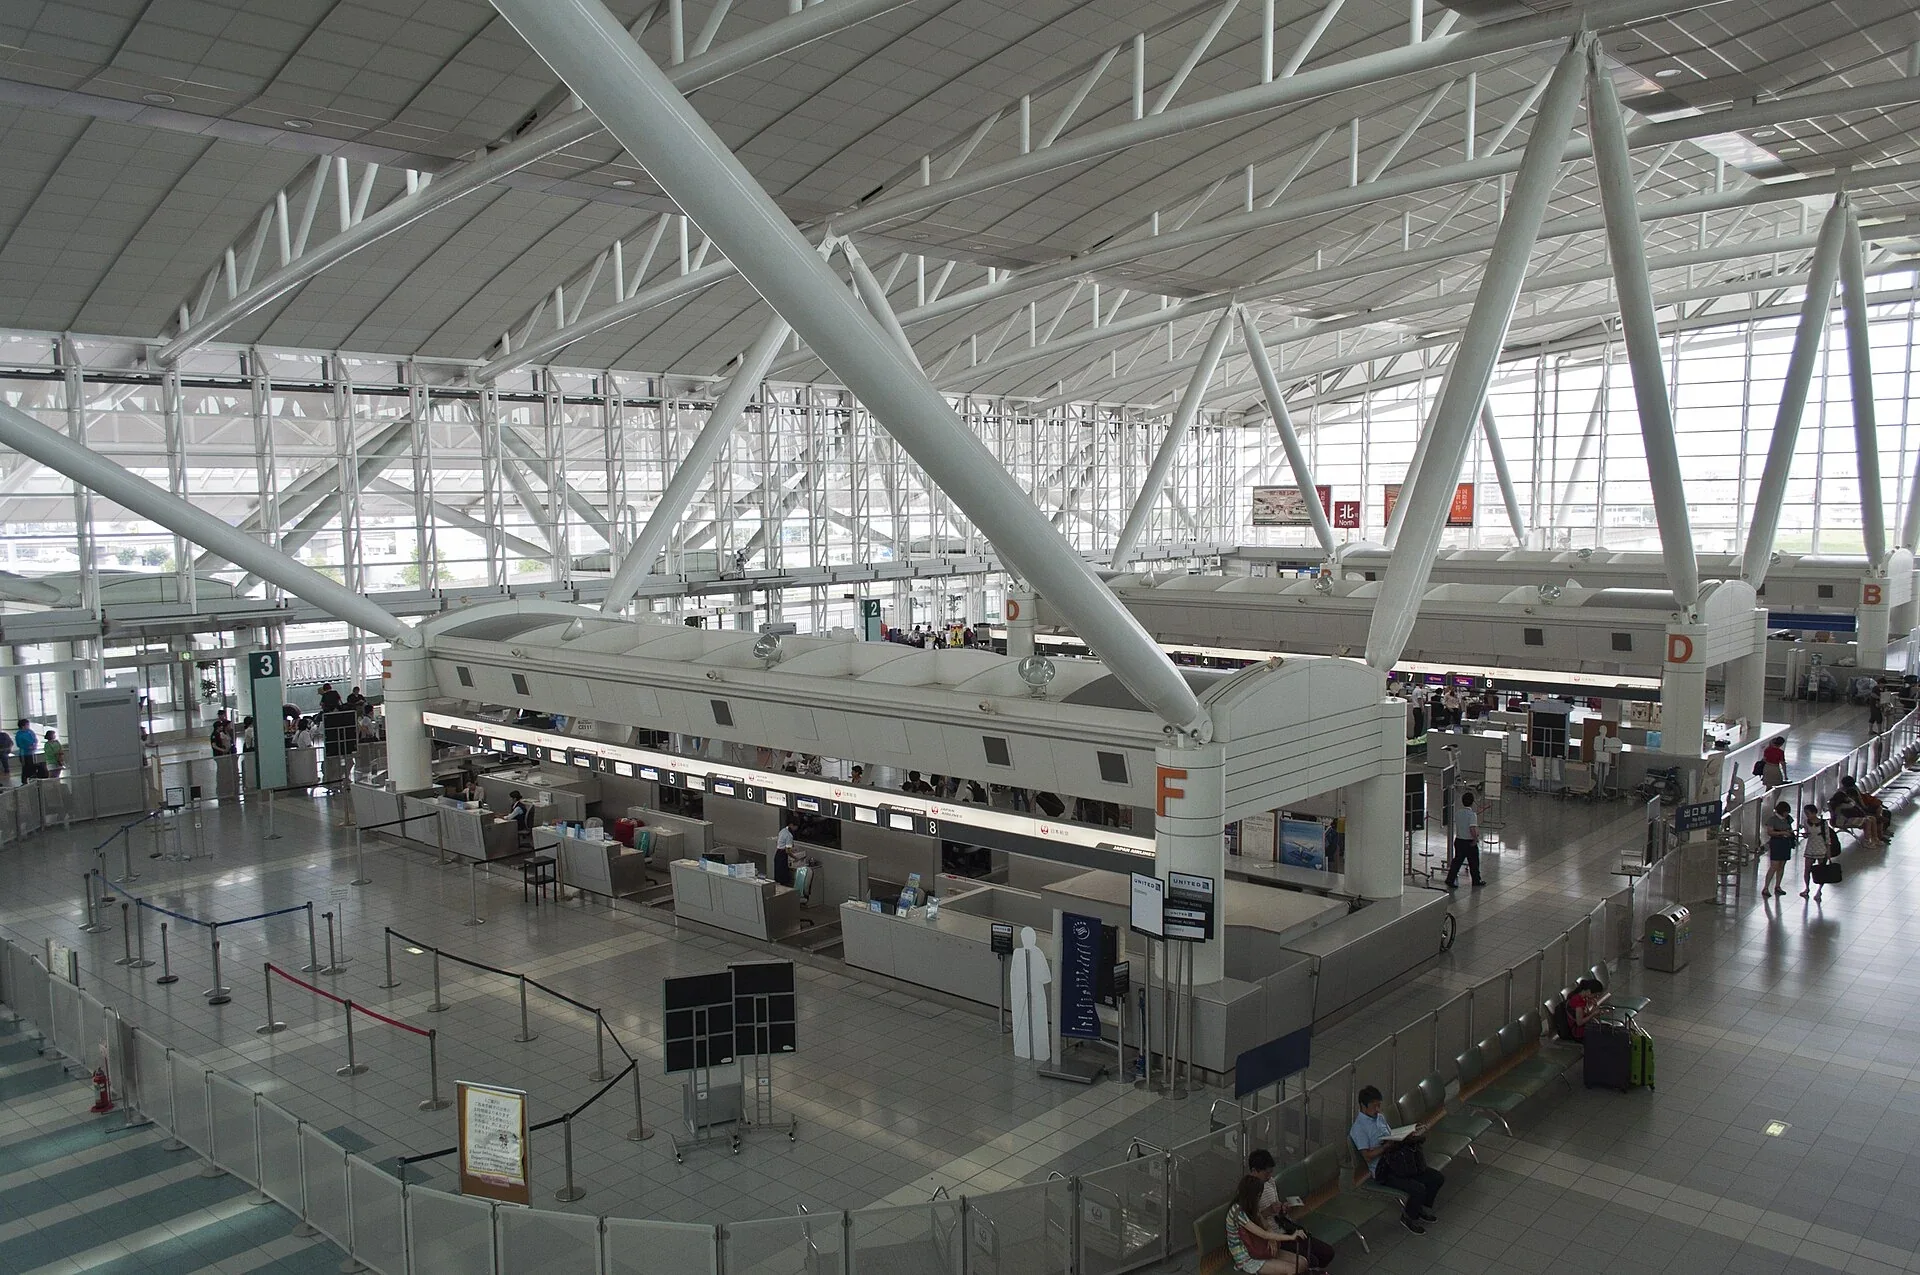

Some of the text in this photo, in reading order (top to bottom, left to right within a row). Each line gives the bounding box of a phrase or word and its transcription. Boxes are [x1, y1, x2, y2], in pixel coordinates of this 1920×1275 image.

[1339, 504, 1354, 519] 北
[1863, 584, 1882, 605] B
[871, 601, 877, 615] 2
[1007, 600, 1019, 621] D
[1668, 633, 1693, 663] D
[260, 655, 273, 675] 3
[1203, 658, 1208, 666] 4
[1407, 673, 1414, 682] 7
[1486, 679, 1493, 688] 8
[431, 728, 436, 737] 1
[478, 737, 483, 747] 2
[536, 747, 542, 758] 3
[599, 760, 606, 771] 4
[669, 772, 675, 784] 5
[746, 787, 753, 799] 6
[1157, 766, 1188, 817] F
[832, 803, 839, 816] 7
[929, 821, 937, 834] 8
[1134, 878, 1155, 889] UNITED
[1173, 879, 1201, 887] UNITED
